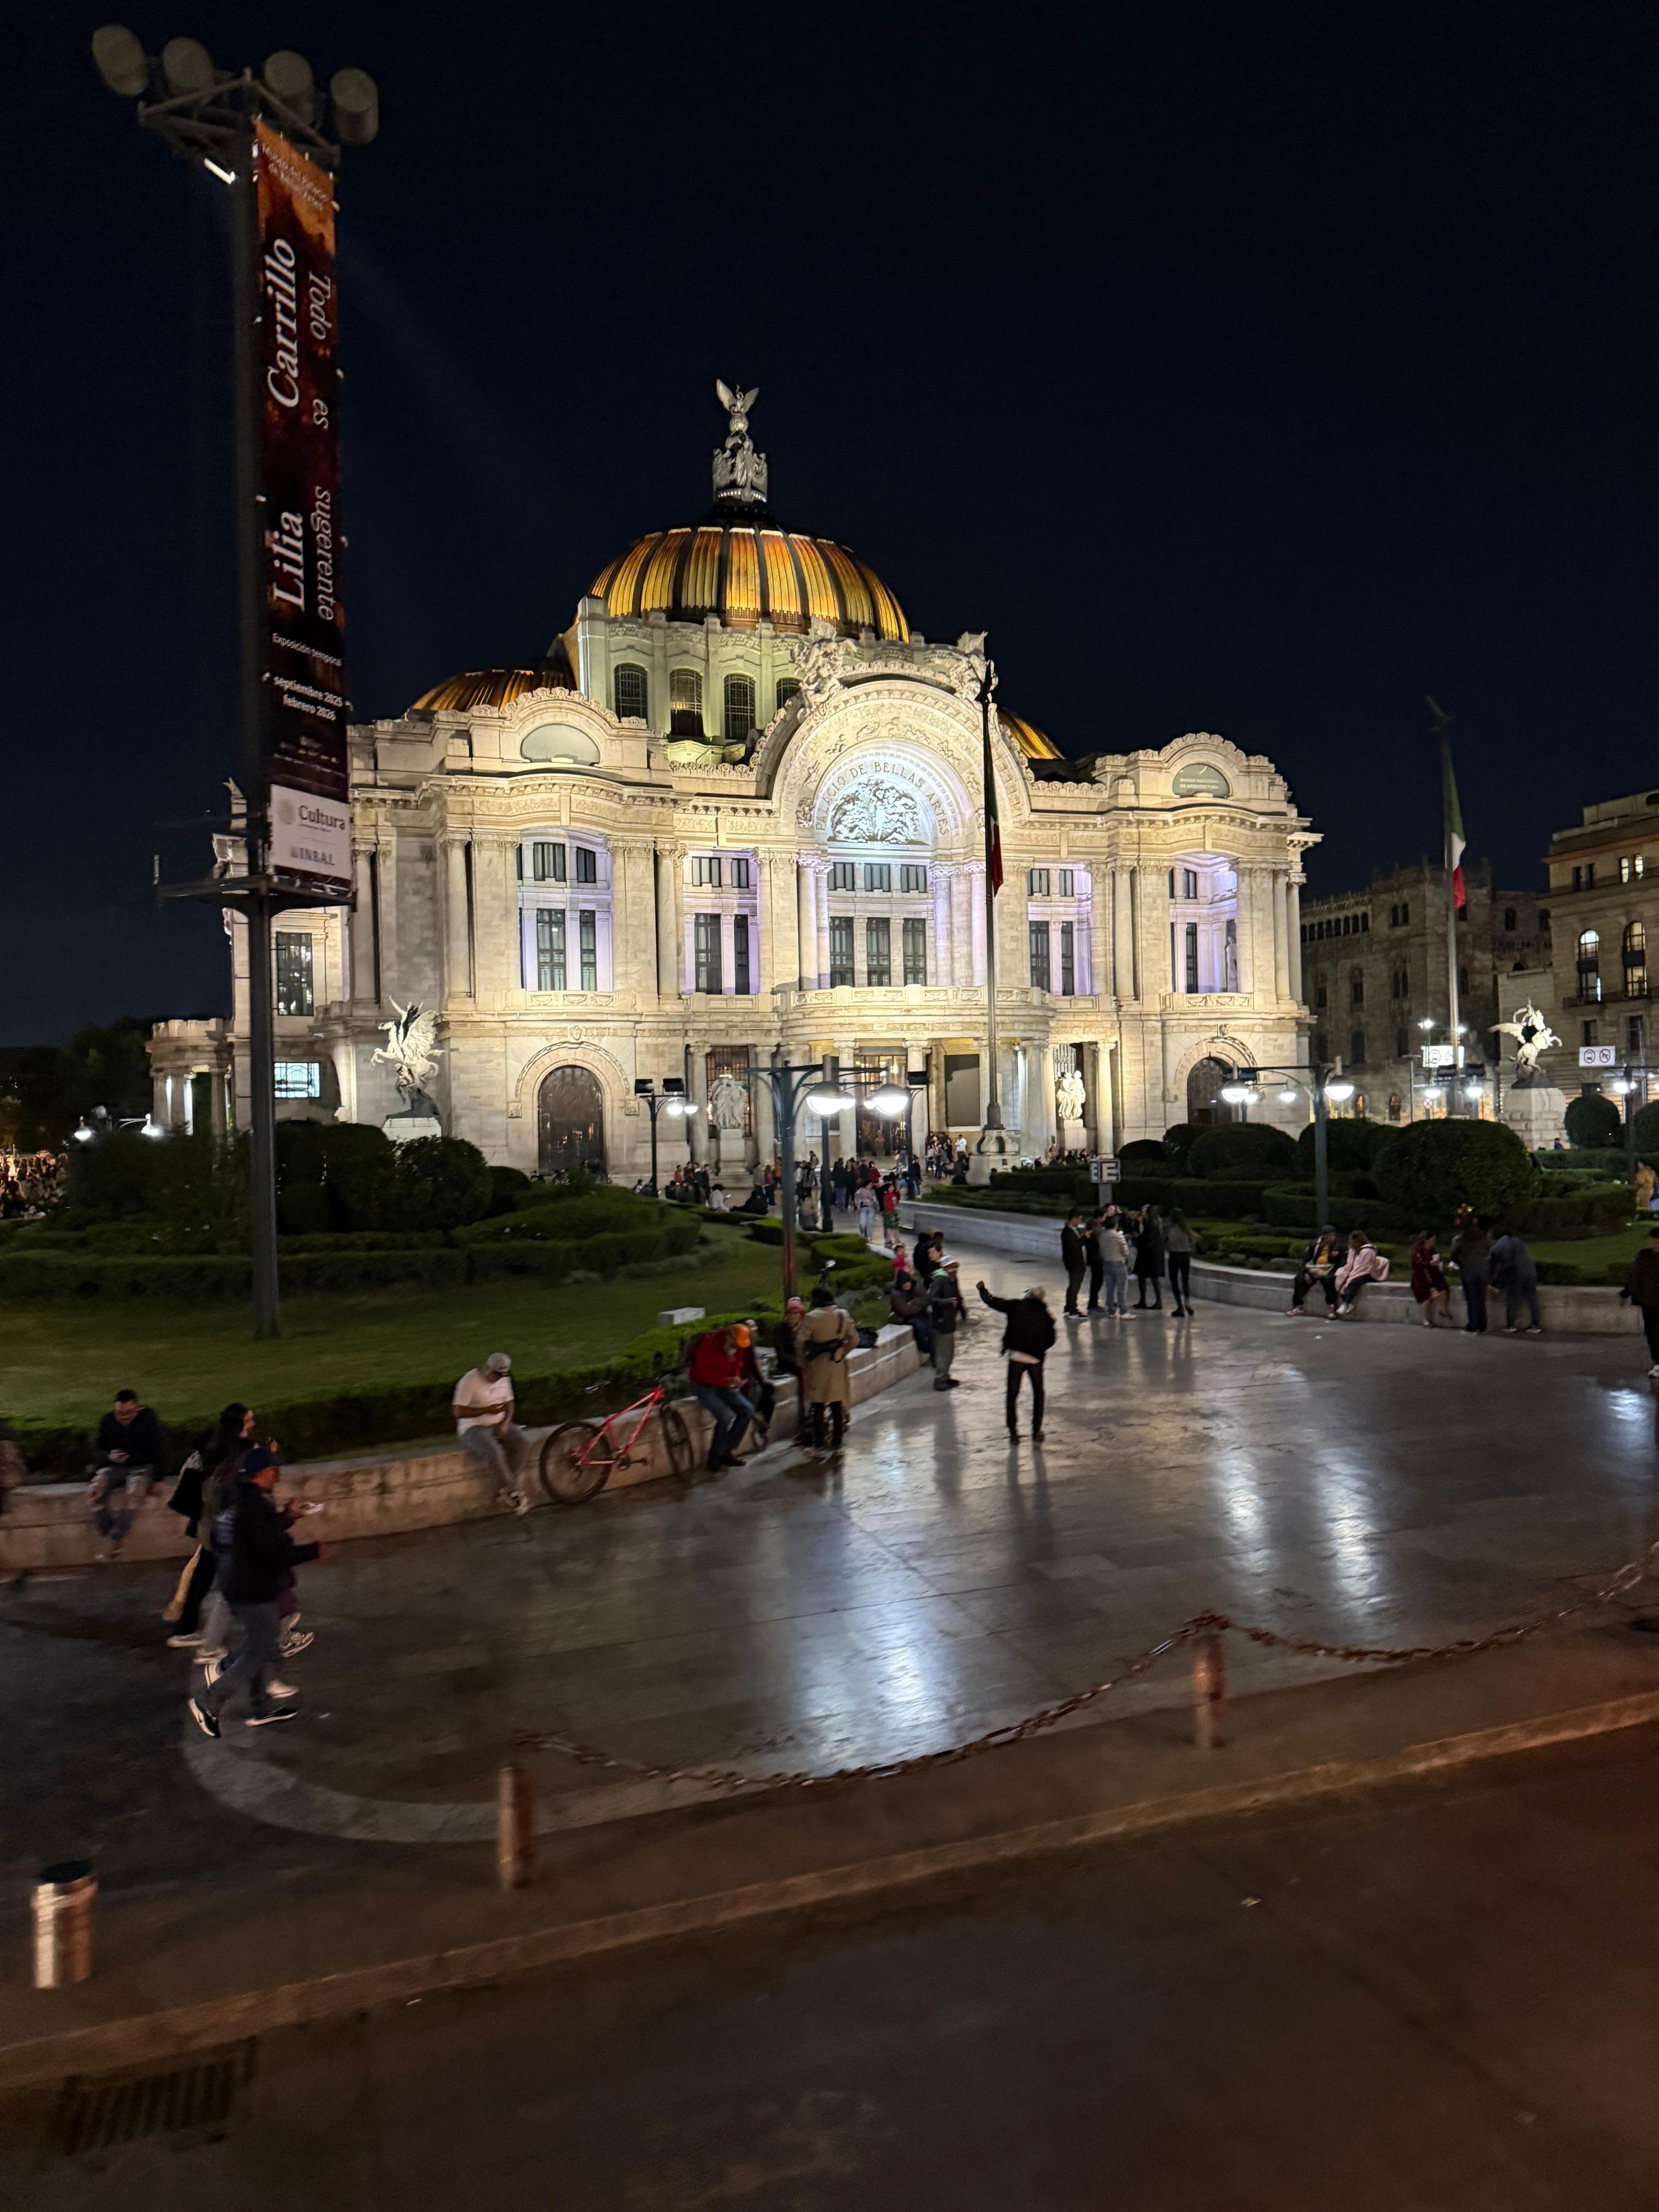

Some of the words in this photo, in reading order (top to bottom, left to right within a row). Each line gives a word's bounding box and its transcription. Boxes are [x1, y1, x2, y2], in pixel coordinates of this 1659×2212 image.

[264, 238, 299, 407] Carrillo
[309, 271, 331, 340] Todo
[313, 399, 328, 430] es
[272, 512, 305, 612] Lilia
[310, 486, 336, 620] sugerente
[273, 677, 324, 701] septiembre
[283, 694, 316, 714] febrero
[299, 805, 345, 830] Cultura
[816, 776, 846, 831] PALACIO
[849, 764, 867, 778] DE
[874, 761, 926, 788] BELLAS
[926, 792, 949, 835] ARTES
[1102, 1162, 1117, 1181] E
